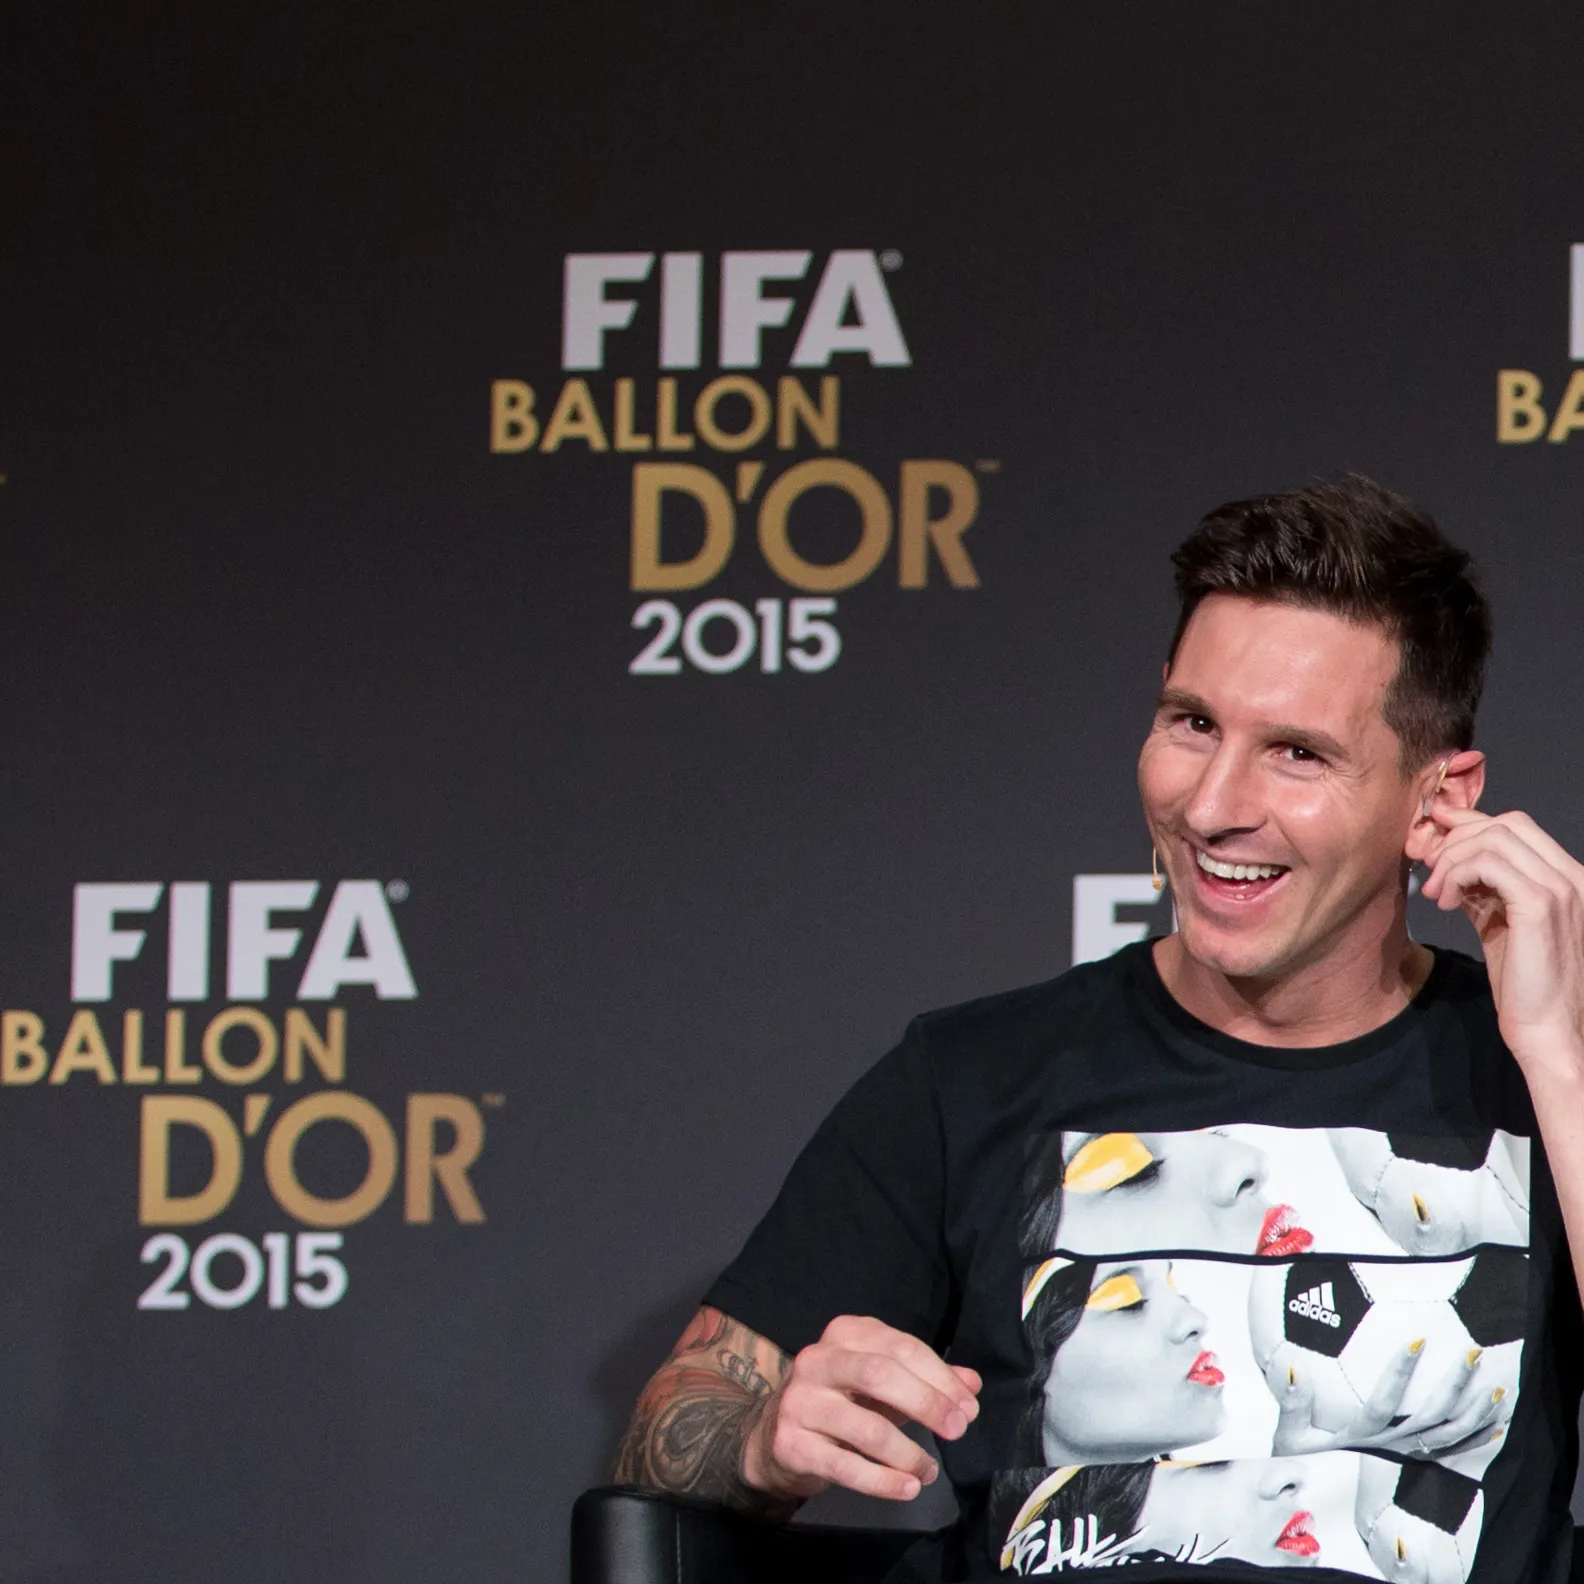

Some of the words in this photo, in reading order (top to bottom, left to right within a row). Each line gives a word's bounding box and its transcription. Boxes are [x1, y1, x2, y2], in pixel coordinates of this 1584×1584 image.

[563, 250, 910, 370] FIFA
[490, 374, 839, 454] BALLON
[630, 457, 979, 593] D'OR
[629, 597, 841, 674] 2015
[70, 879, 418, 1003] FIFA
[0, 1005, 346, 1086] BALLON
[138, 1090, 484, 1227] D'OR
[137, 1231, 348, 1310] 2015
[1288, 1299, 1342, 1329] adidas
